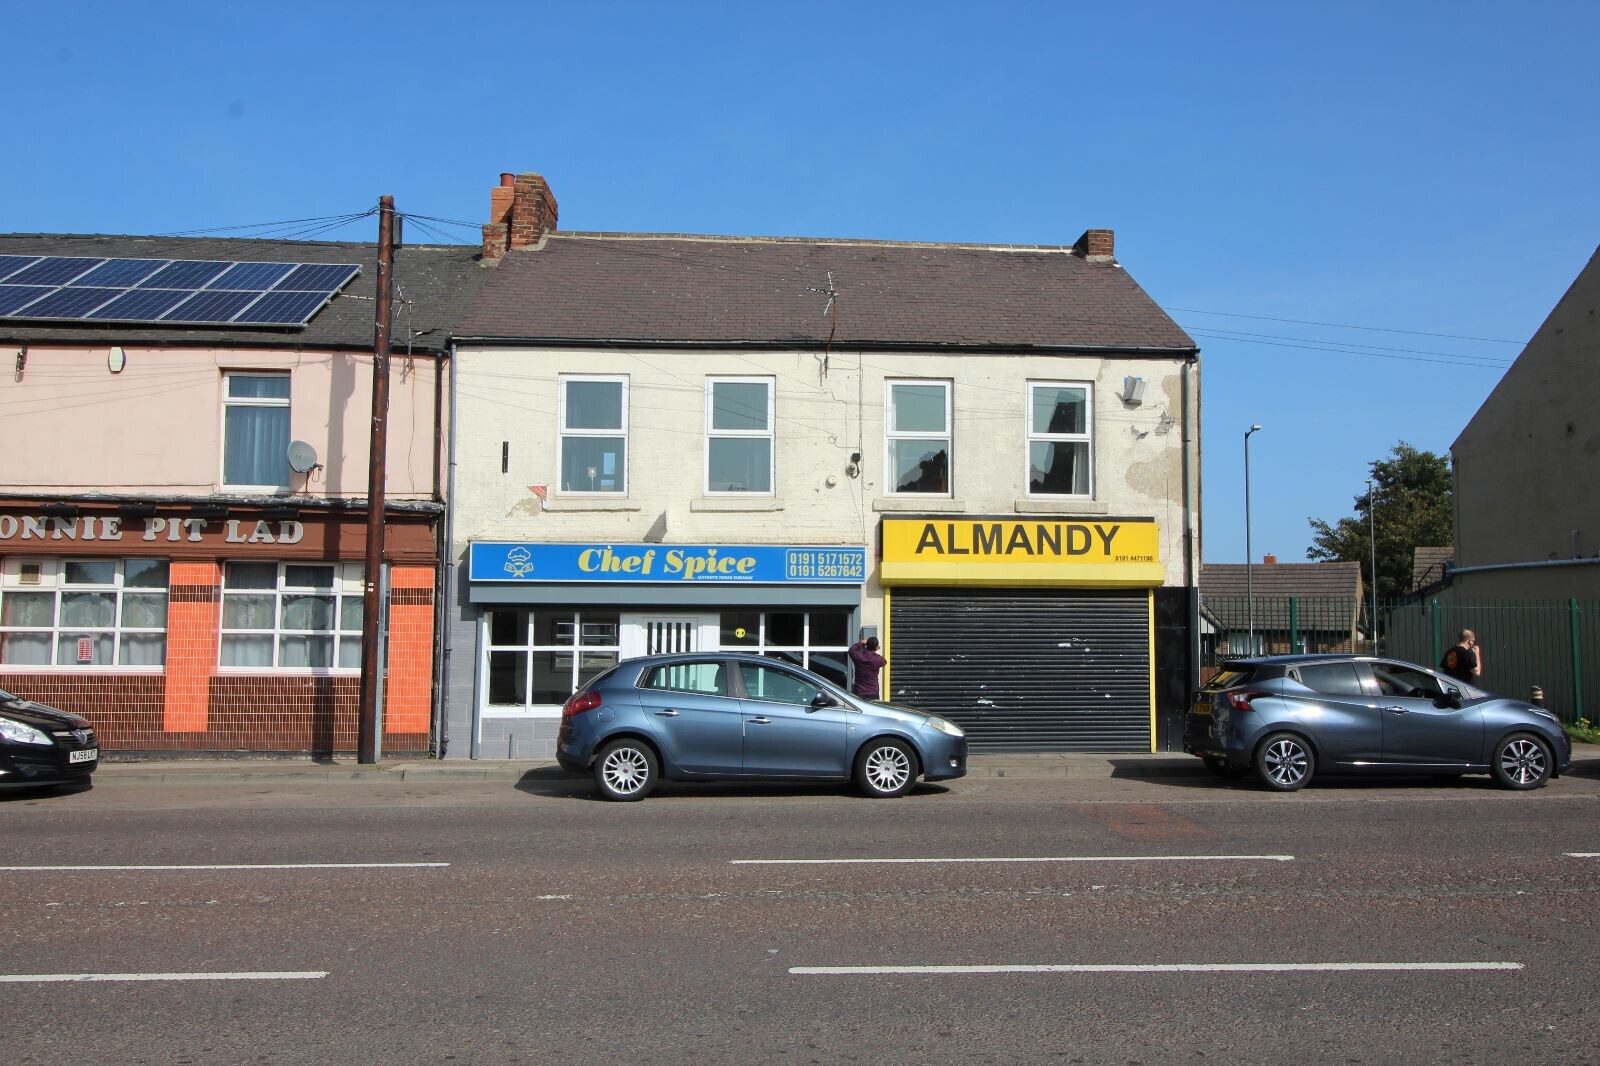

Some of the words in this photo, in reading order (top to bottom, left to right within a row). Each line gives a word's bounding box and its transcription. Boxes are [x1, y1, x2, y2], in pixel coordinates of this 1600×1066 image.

[143, 517, 208, 542] PIT
[225, 519, 304, 544] LAD
[915, 523, 1121, 556] ALMANDY
[578, 548, 656, 575] Chef
[664, 548, 757, 580] Spice
[790, 553, 815, 564] 0191
[818, 553, 862, 565] 5171572
[790, 565, 815, 576] 0191
[818, 565, 862, 577] 5267642
